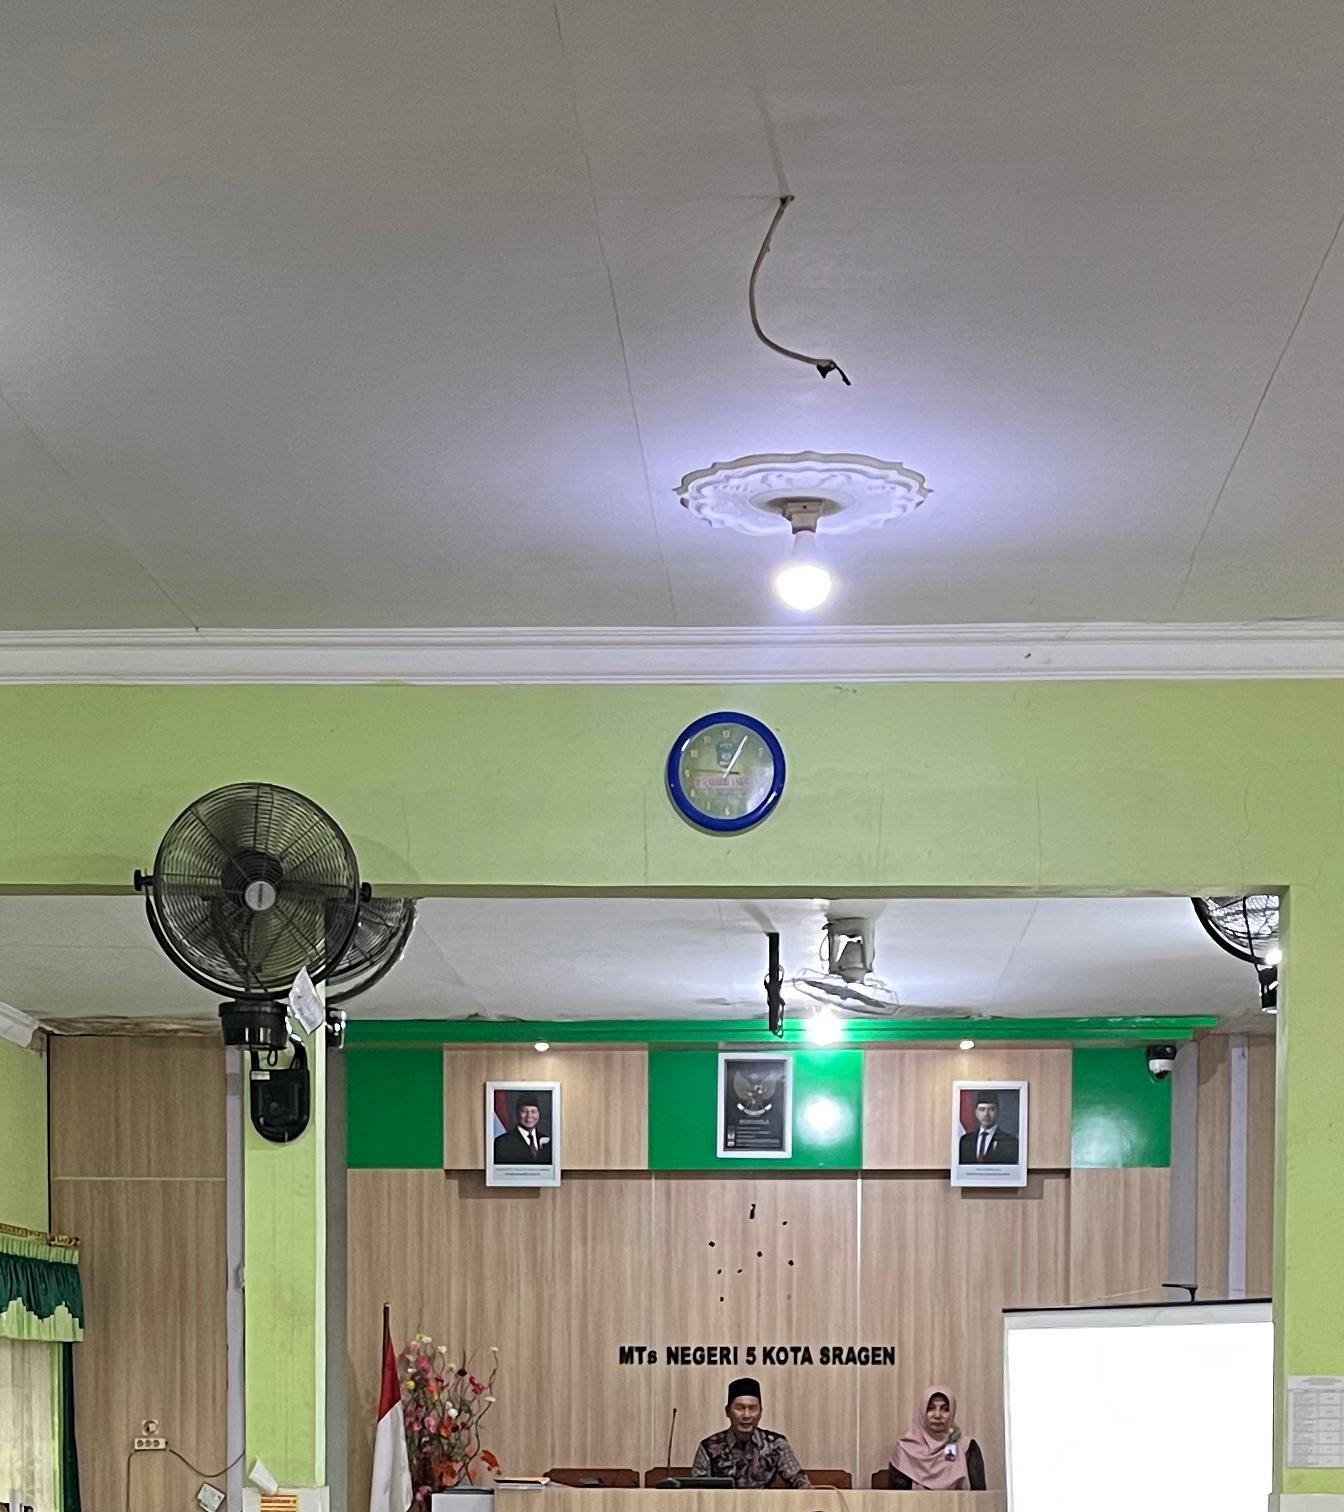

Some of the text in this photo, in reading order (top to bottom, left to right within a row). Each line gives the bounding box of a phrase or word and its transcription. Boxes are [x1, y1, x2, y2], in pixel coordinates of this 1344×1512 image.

[619, 1346, 895, 1365] MTs NEGERI 5 KOTA SRAGEN
